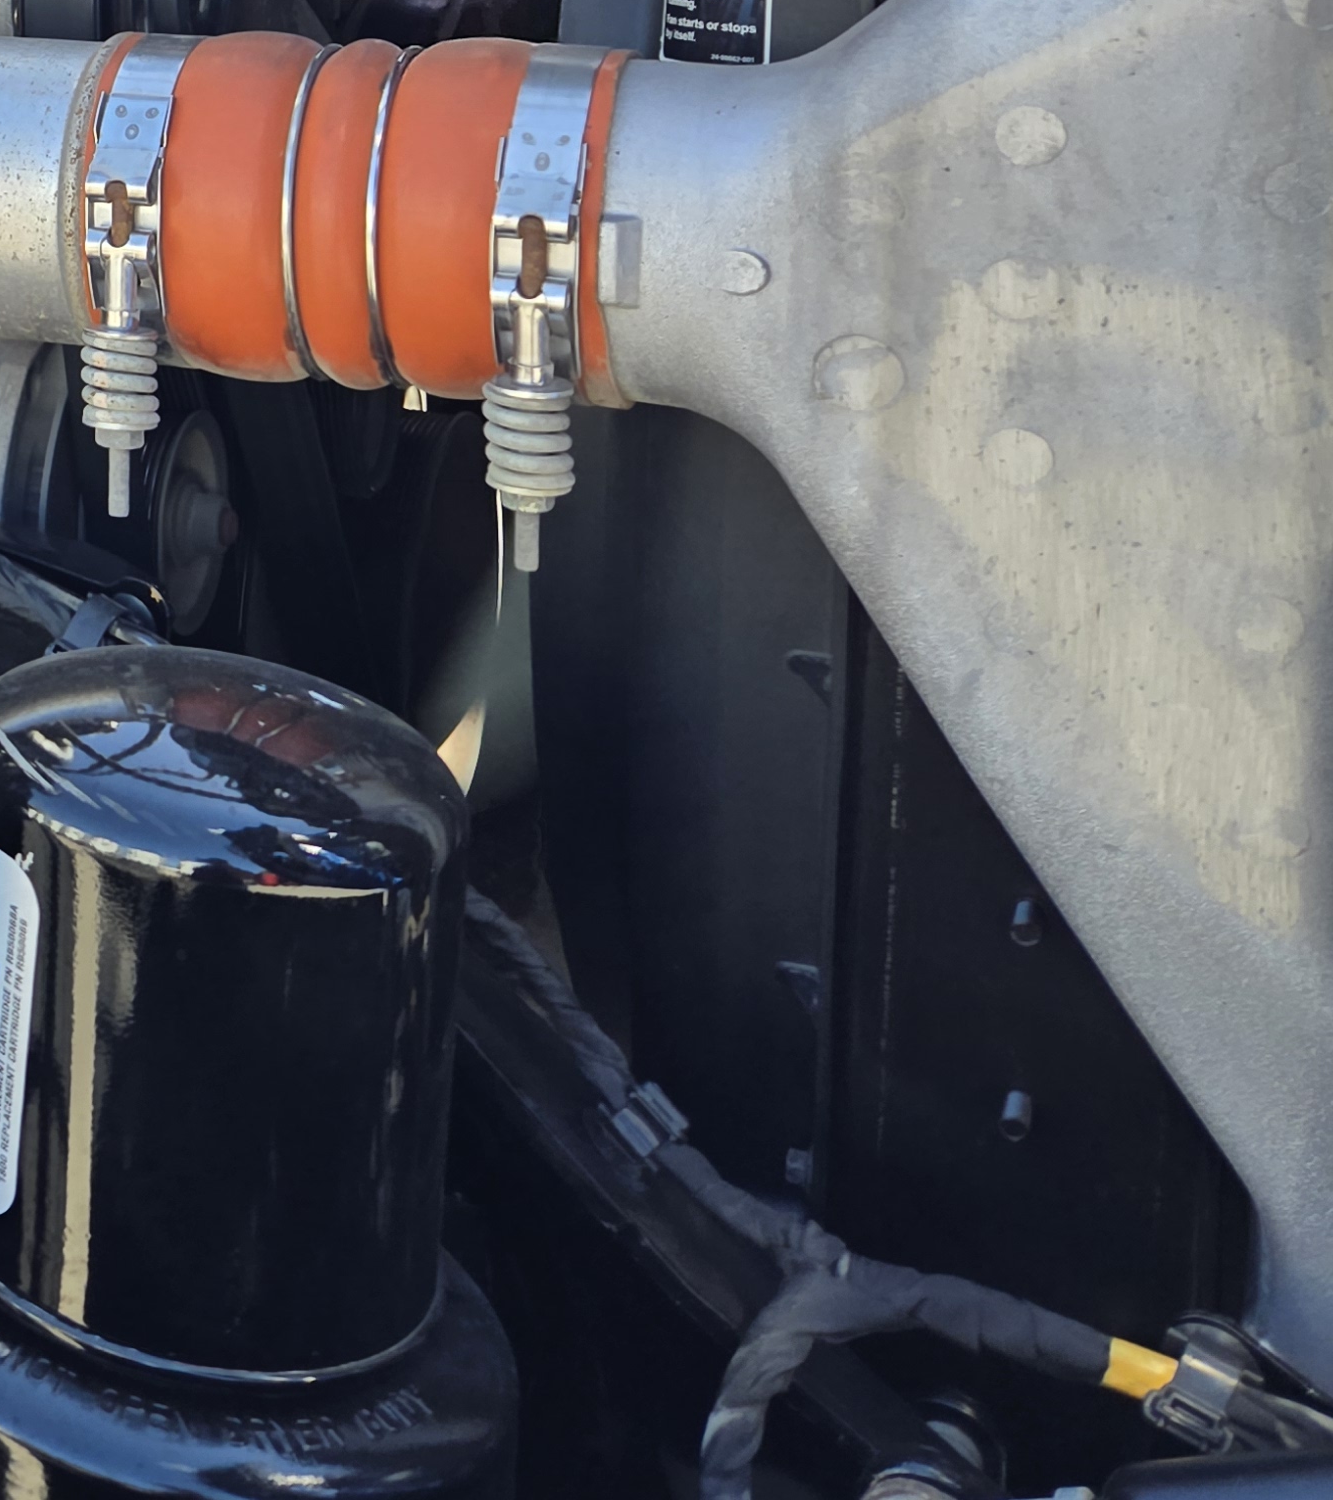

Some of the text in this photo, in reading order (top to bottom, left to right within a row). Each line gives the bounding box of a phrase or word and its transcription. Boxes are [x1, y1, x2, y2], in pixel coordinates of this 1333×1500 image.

[678, 17, 704, 30] starts
[706, 22, 720, 31] or
[721, 23, 757, 36] stops
[4, 966, 14, 985] PN
[14, 974, 24, 992] PN
[7, 995, 22, 1063] CARTRIDGE
[1, 1064, 16, 1152] REPLACEMENT
